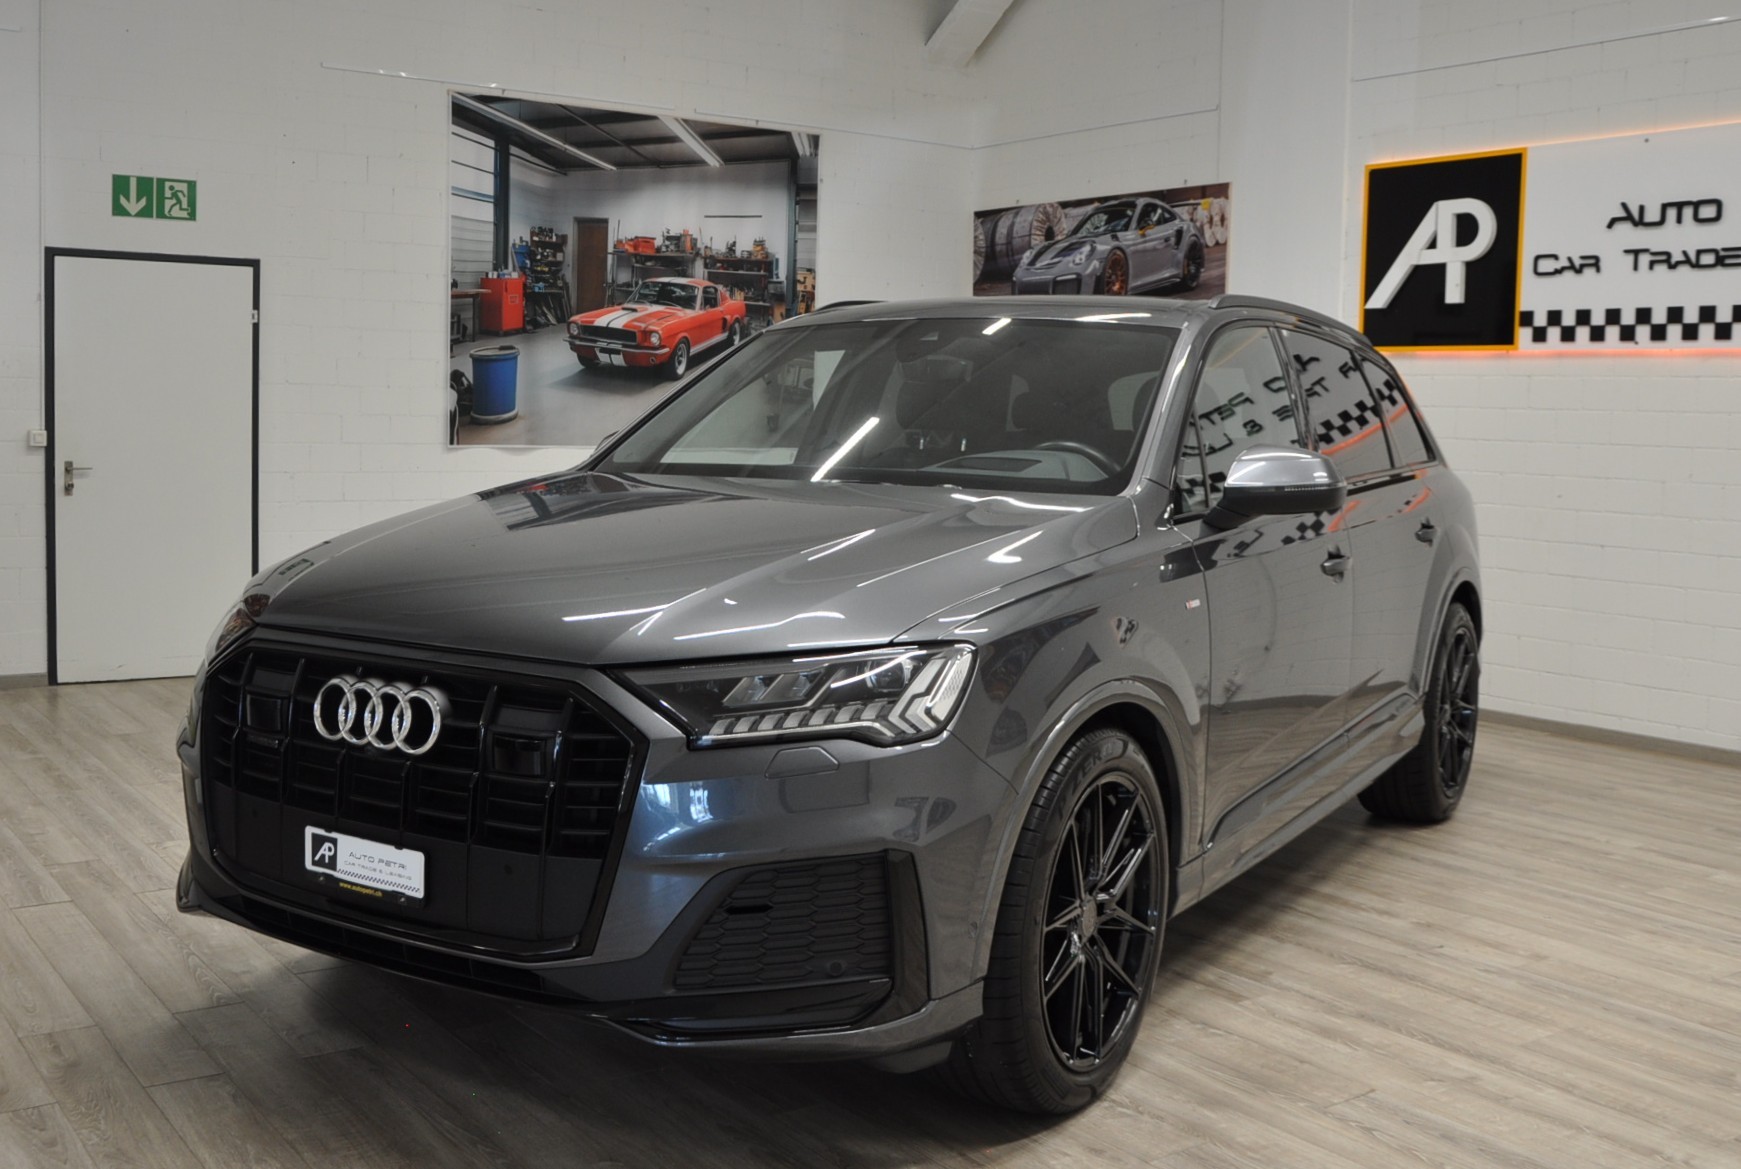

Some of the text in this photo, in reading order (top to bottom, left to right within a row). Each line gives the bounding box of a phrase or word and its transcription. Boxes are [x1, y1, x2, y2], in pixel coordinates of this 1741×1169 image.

[1606, 198, 1723, 229] AUTO
[1533, 254, 1601, 276] CAR
[348, 851, 407, 870] AUTO PETRI
